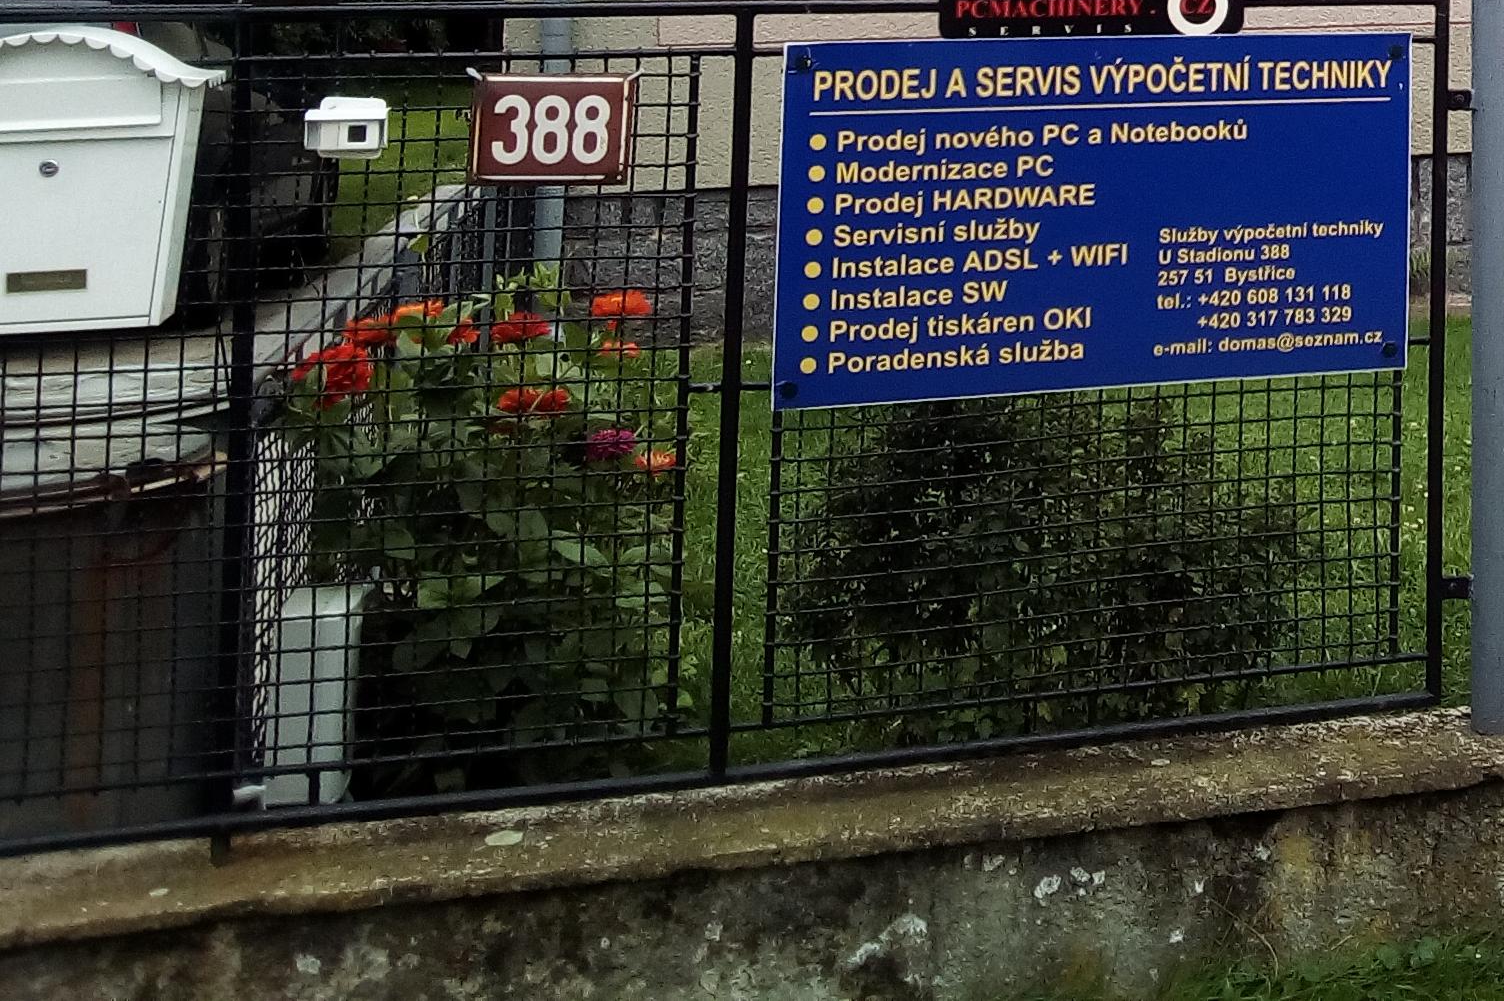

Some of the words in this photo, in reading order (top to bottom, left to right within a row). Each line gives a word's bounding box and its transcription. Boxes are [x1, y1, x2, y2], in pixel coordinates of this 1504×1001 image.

[813, 68, 937, 101] PRODEJ
[944, 68, 967, 98] A
[975, 65, 1081, 98] SERVIS
[1089, 55, 1251, 95] VÝPOČETNÍ
[1257, 59, 1392, 91] TECHNIKY
[491, 94, 611, 165] 388
[837, 128, 926, 156] Prodej
[935, 125, 1034, 150] nového
[1042, 123, 1080, 146] PC
[1087, 128, 1102, 145] a
[1110, 118, 1248, 144] Notebooků
[836, 158, 1008, 184] Modernizace
[1016, 154, 1054, 178] PC
[835, 190, 925, 219] Prodej
[933, 183, 1096, 212] HARDWARE
[833, 220, 946, 247] Servisní
[953, 217, 1041, 244] služby
[1159, 226, 1219, 246] Služby
[1223, 221, 1309, 245] výpočetní
[1312, 219, 1384, 239] techniky
[832, 253, 955, 279] Instalace
[962, 248, 1039, 273] ADSL
[1047, 249, 1063, 266] +
[1070, 243, 1128, 267] WIFI
[1158, 249, 1172, 265] U
[1177, 246, 1255, 264] Stadionu
[1260, 243, 1290, 260] 388
[1157, 269, 1190, 286] 257
[1194, 268, 1213, 285] 51
[1224, 265, 1296, 287] Bystřice
[831, 285, 954, 311] Instalace
[962, 281, 1008, 304] SW
[1156, 292, 1192, 310] tel.:
[1197, 288, 1242, 307] +420
[1246, 287, 1279, 305] 608
[1285, 285, 1314, 303] 131
[1322, 283, 1351, 301] 118
[829, 317, 919, 344] Prodej
[926, 311, 1034, 337] tiskáren
[1043, 306, 1091, 330] OKI
[1197, 311, 1241, 329] +420
[1246, 310, 1279, 327] 317
[1283, 308, 1315, 326] 783
[1320, 305, 1352, 323] 329
[828, 342, 990, 374] Poradenská
[998, 338, 1084, 364] služba
[1153, 338, 1213, 356] e-mail:
[1218, 331, 1383, 353] domas@seznam.cz
